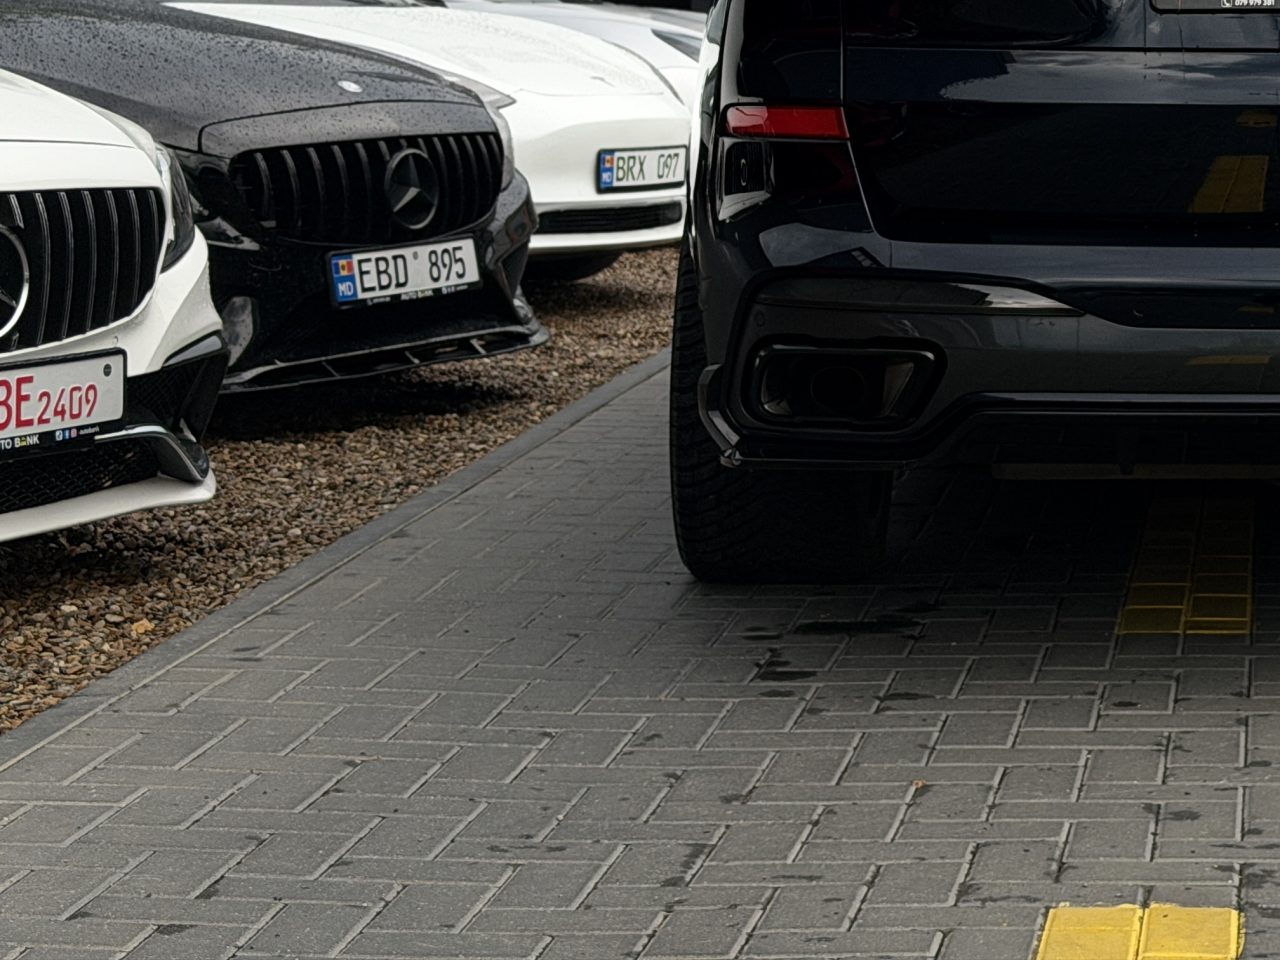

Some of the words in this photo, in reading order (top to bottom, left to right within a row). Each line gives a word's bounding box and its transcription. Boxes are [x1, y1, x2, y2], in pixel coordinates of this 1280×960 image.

[615, 155, 647, 182] BRX
[657, 152, 680, 180] 097
[337, 281, 354, 297] MD
[357, 254, 409, 293] EBD
[428, 246, 466, 283] 895
